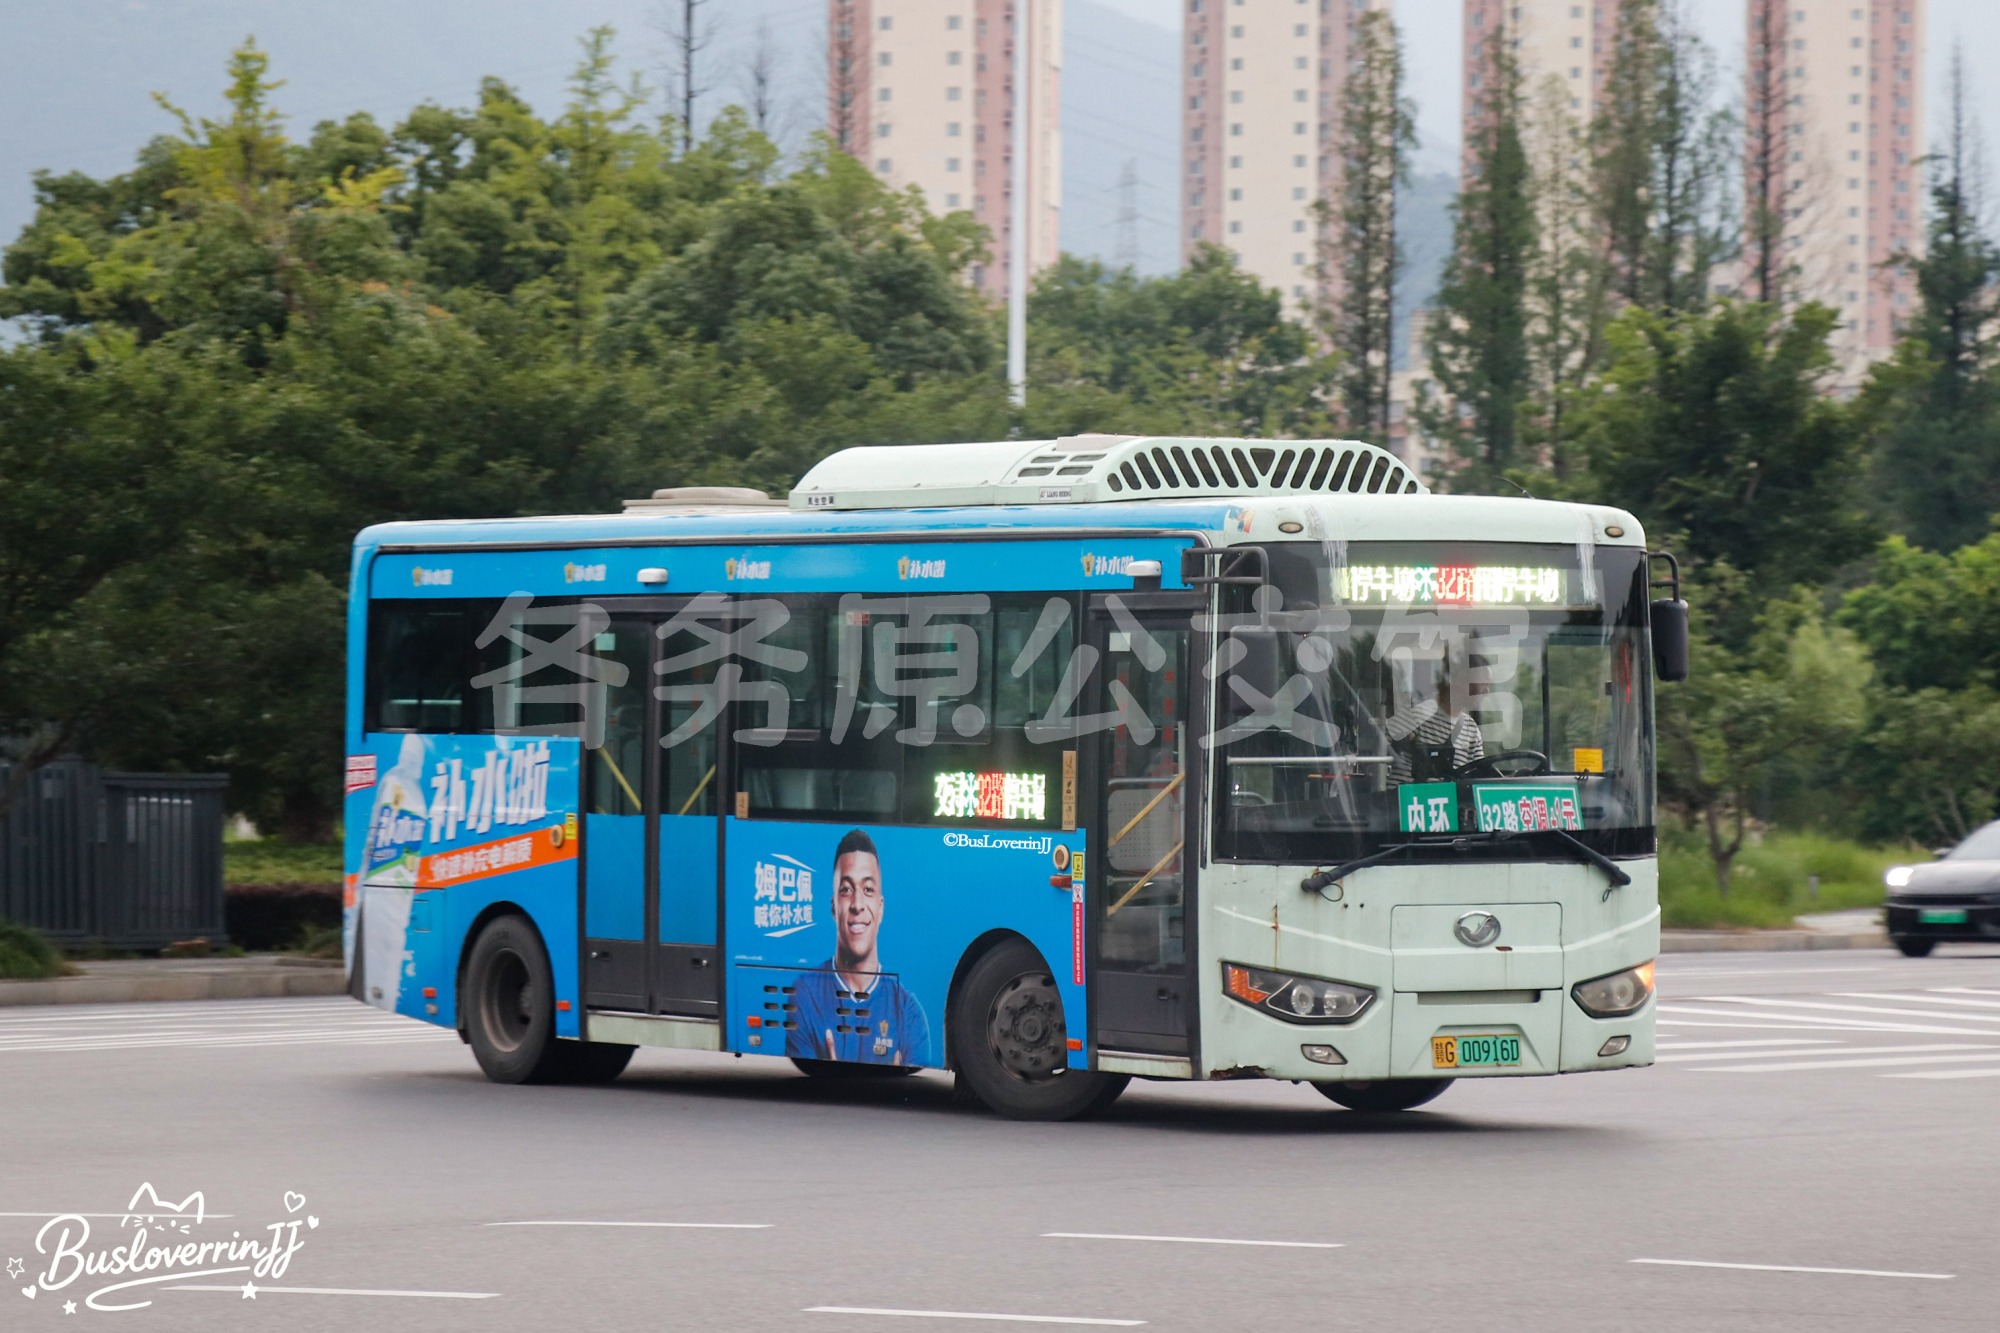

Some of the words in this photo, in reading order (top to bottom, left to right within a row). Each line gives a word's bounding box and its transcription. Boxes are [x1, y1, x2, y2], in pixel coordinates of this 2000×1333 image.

[429, 740, 550, 843] 补水啦
[1408, 797, 1450, 832] 内环
[754, 861, 813, 902] 姆巴佩
